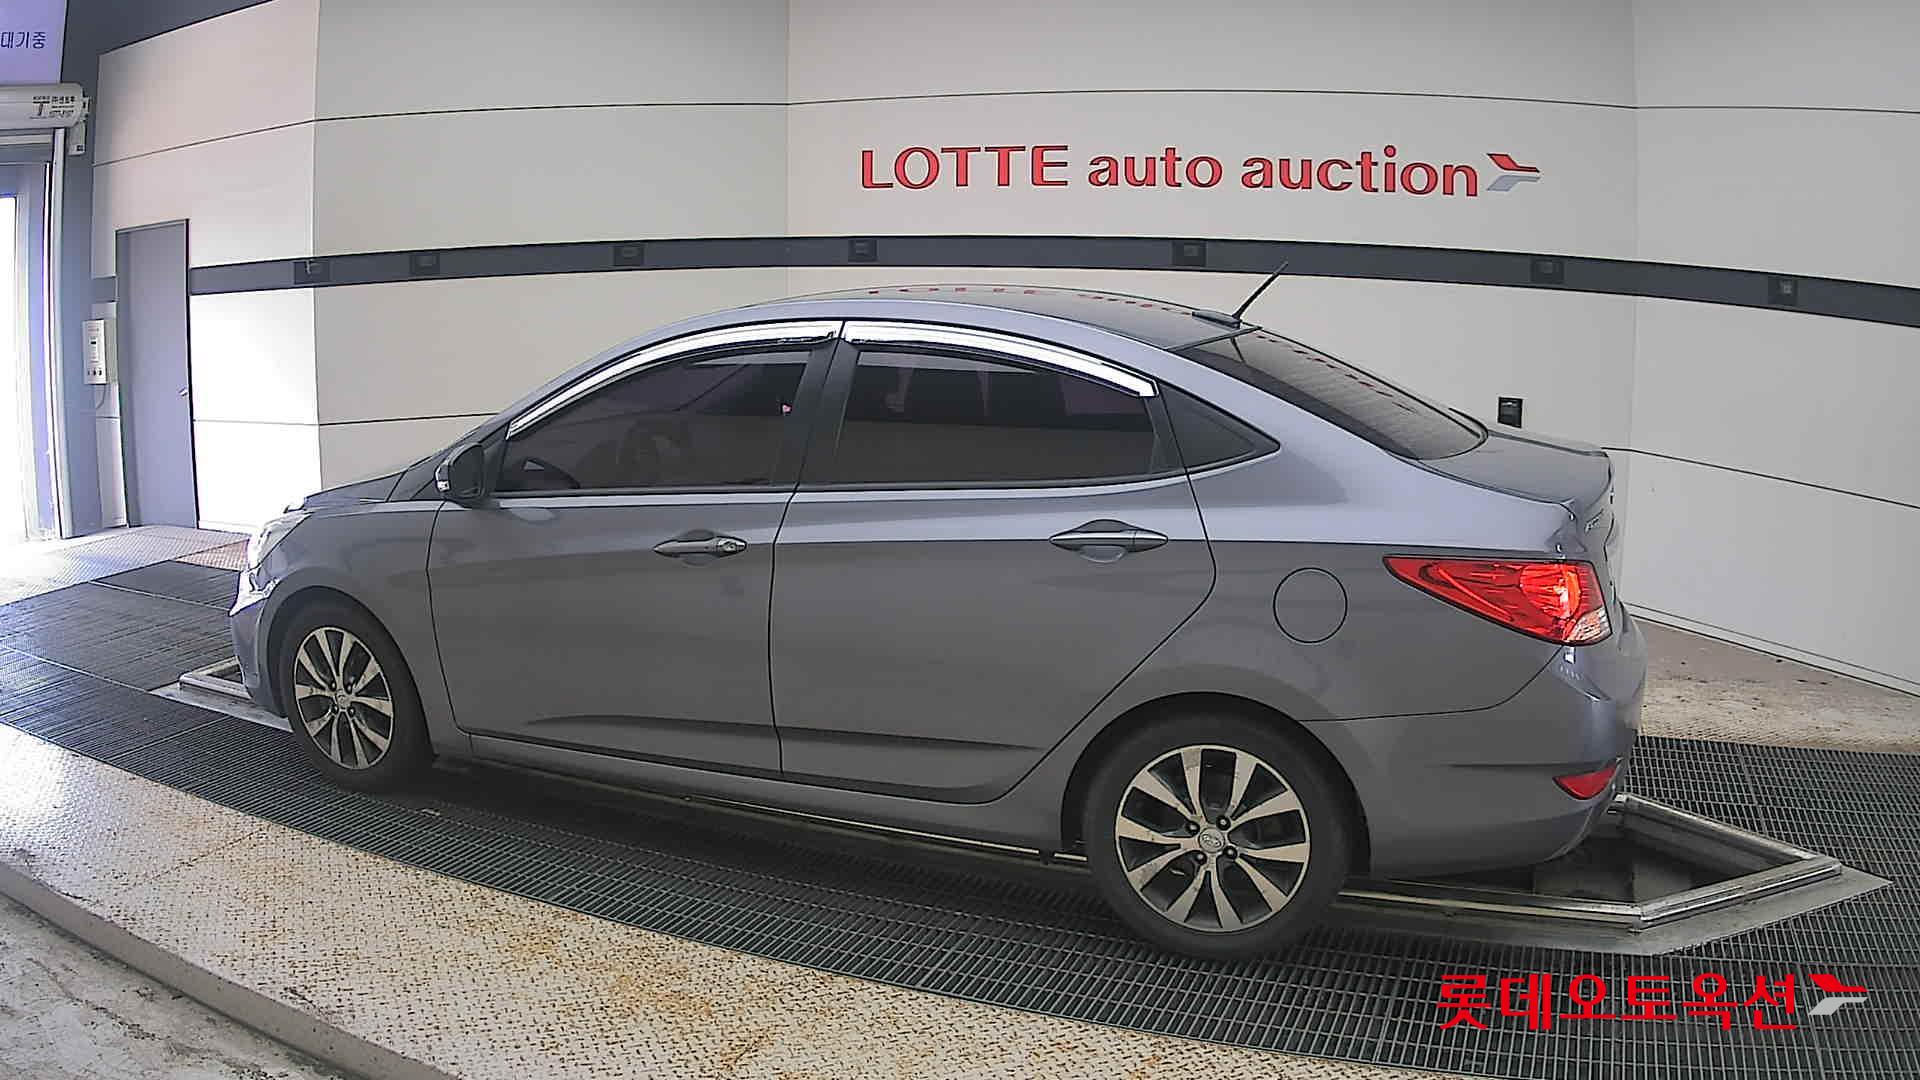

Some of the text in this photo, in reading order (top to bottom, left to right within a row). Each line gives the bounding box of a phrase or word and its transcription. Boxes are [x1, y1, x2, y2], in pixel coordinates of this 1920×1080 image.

[0, 31, 47, 49] 대기중
[861, 144, 1479, 198] LOTTE auto auction
